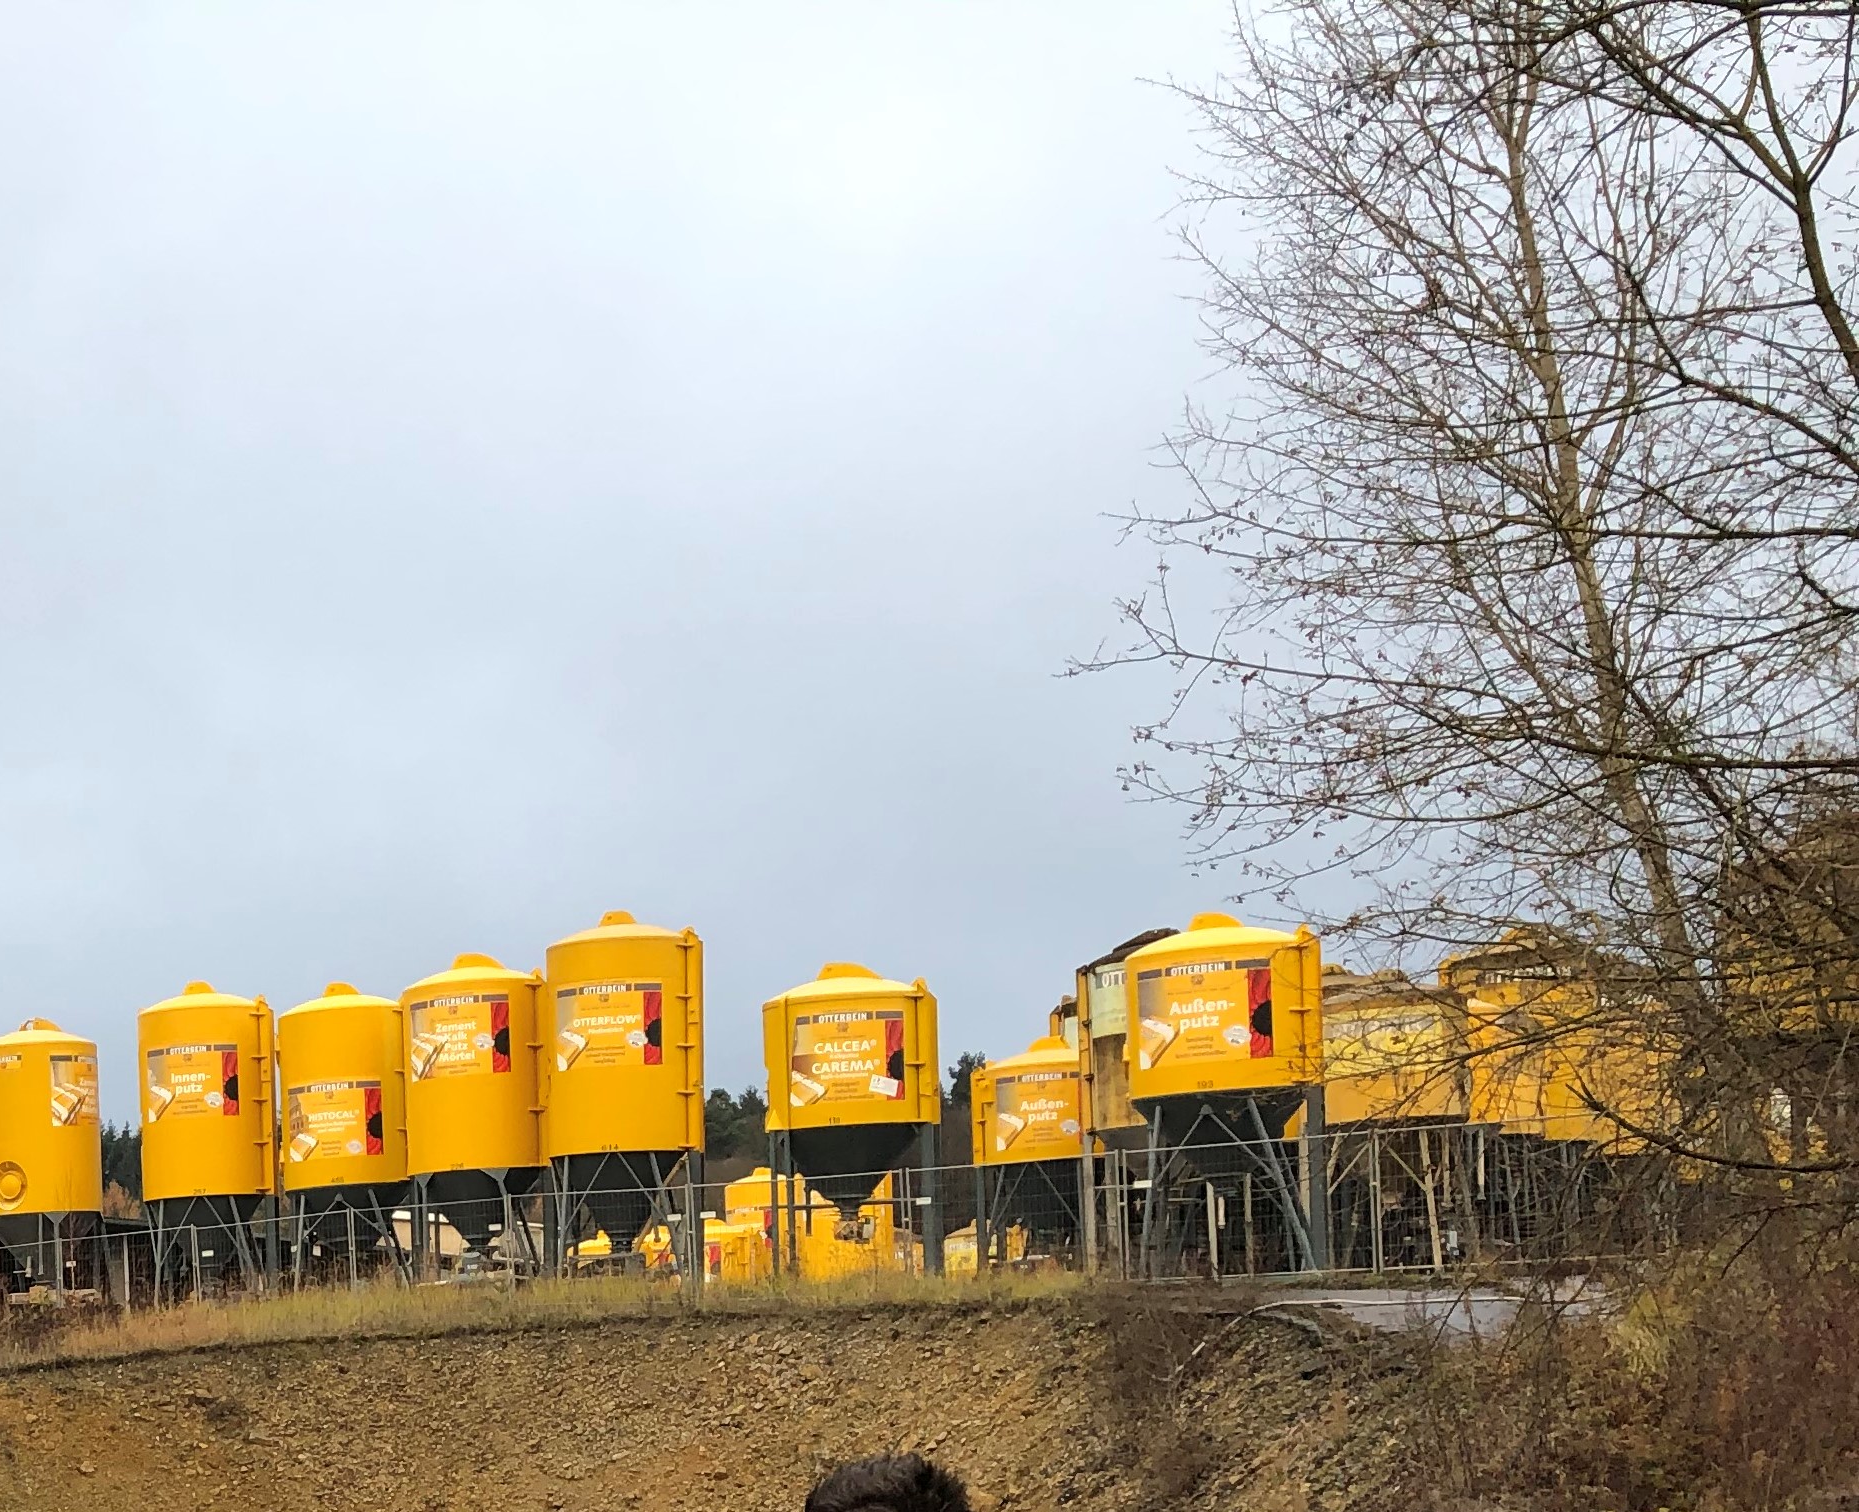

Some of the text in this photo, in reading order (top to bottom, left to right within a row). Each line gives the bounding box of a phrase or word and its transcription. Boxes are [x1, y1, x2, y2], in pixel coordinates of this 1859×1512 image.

[1170, 962, 1225, 977] OTTERBEIN
[583, 984, 627, 995] OTTERBEIN
[434, 996, 474, 1007] OTTERBEIN
[1169, 998, 1236, 1016] Außen-
[819, 1012, 867, 1024] OTTERBEIN
[1180, 1014, 1219, 1034] putz
[436, 1021, 477, 1033] Zement
[170, 1045, 207, 1055] OTTERBEIN
[439, 1050, 476, 1062] Mörtel
[171, 1072, 212, 1083] Innen-
[1022, 1073, 1062, 1082] OTTERBEIN
[175, 1083, 203, 1097] putz
[310, 1082, 349, 1092] OTTERBEIN
[1020, 1098, 1069, 1111] Außen-
[1028, 1110, 1058, 1125] putz
